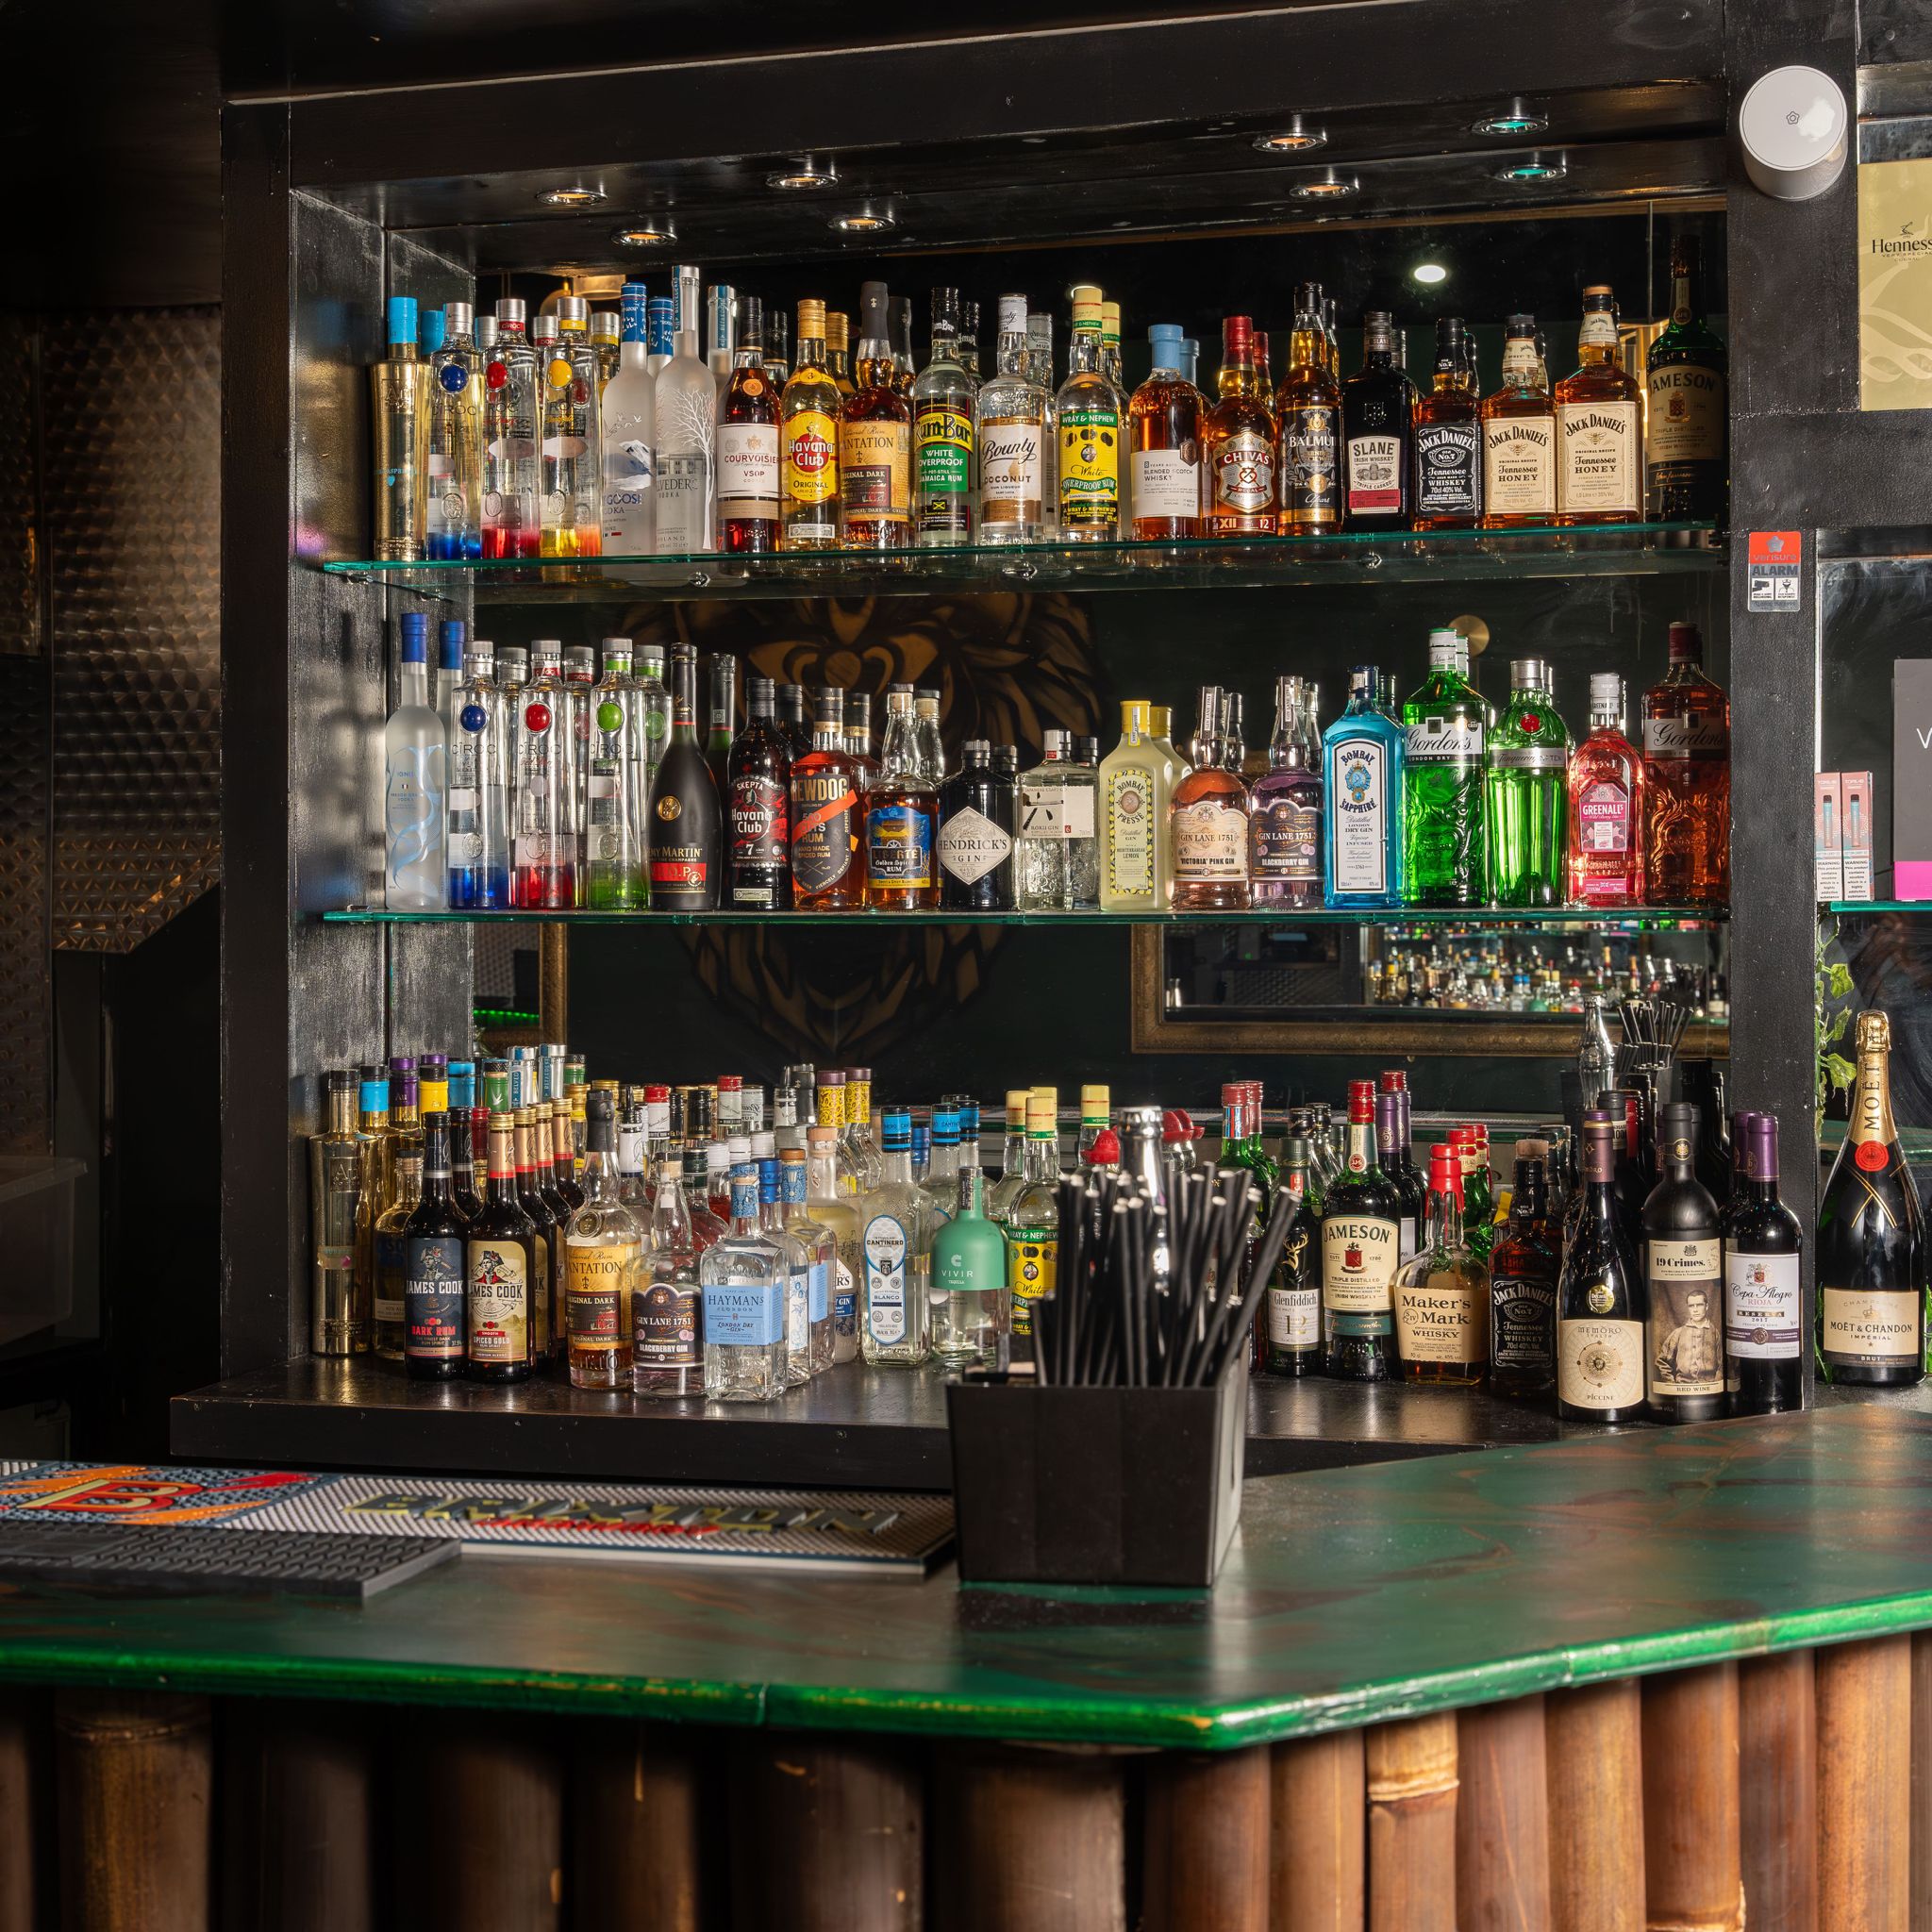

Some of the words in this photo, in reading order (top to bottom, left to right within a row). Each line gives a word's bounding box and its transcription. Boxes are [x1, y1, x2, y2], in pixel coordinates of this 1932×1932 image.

[1873, 239, 1932, 254] Henness
[1648, 373, 1715, 397] JAMESON
[1062, 415, 1079, 424] WRAY
[1089, 414, 1114, 424] NEPHEW
[1566, 417, 1589, 437] JACK
[1589, 413, 1627, 435] DANIEL'S
[842, 437, 893, 449] ANTATION
[1290, 435, 1336, 448] BALMUI
[1418, 437, 1441, 454] JACK
[1441, 430, 1477, 450] DANIEL'S
[1489, 430, 1510, 449] JACK
[1511, 425, 1550, 447] DANIEL'S
[789, 440, 834, 453] Havana
[983, 438, 1037, 468] Bounty
[1353, 441, 1394, 457] SLANE
[796, 453, 824, 466] Club
[925, 449, 953, 458] WHITE
[1224, 452, 1270, 465] CHIVAS
[1574, 456, 1616, 465] Tennessee
[1071, 464, 1108, 475] White
[1427, 466, 1467, 476] Tennessee
[1498, 464, 1538, 474] Tennessee
[1574, 465, 1618, 474] HONEY
[793, 480, 828, 489] ORIGINAL
[984, 475, 1031, 483] COCONUT
[1498, 474, 1538, 482] HONEY
[1062, 479, 1100, 491] OVERPROOF
[1219, 518, 1237, 528] XII
[1259, 518, 1270, 529] 12
[1752, 565, 1798, 575] ALARM
[1407, 728, 1472, 752] Gordon's
[1341, 750, 1375, 764] BOMBAY
[737, 781, 763, 791] SKEPTA
[791, 778, 848, 802] REWDOG
[1117, 780, 1145, 793] BOMBAY
[1340, 799, 1377, 813] SAPPHIRE
[732, 808, 772, 821] Havana
[738, 822, 762, 833] Club
[802, 833, 824, 842] RUM
[1258, 832, 1270, 841] GIN
[1272, 832, 1293, 841] LANE
[1295, 832, 1312, 841] 1751
[745, 843, 755, 855] 7
[937, 839, 1008, 850] HENDRICK'S
[662, 846, 701, 858] MARTIN
[1863, 1065, 1880, 1131] MOËT
[1323, 1224, 1390, 1243] JAMESON
[568, 1260, 623, 1274] ANTATION
[1656, 1257, 1665, 1267] 19
[1666, 1258, 1706, 1267] Crimes.
[407, 1281, 435, 1294] JAMES
[439, 1280, 464, 1294] COOK
[497, 1285, 523, 1299] COOK
[1015, 1281, 1047, 1294] White
[1731, 1283, 1754, 1300] Cepa
[1274, 1292, 1317, 1307] Glenfiddich
[1494, 1287, 1517, 1306] JACK
[1518, 1283, 1556, 1306] DANIEL'S
[1402, 1295, 1472, 1309] Maker's
[649, 1317, 672, 1325] LANE
[673, 1317, 691, 1325] 1751
[1421, 1311, 1471, 1325] Mark
[411, 1325, 433, 1336] DARK
[436, 1325, 456, 1335] RUM
[1503, 1322, 1543, 1331] Tennessee
[1830, 1322, 1856, 1332] MOËT
[1865, 1324, 1913, 1333] CHANDON
[1411, 1330, 1461, 1339] WHISKY
